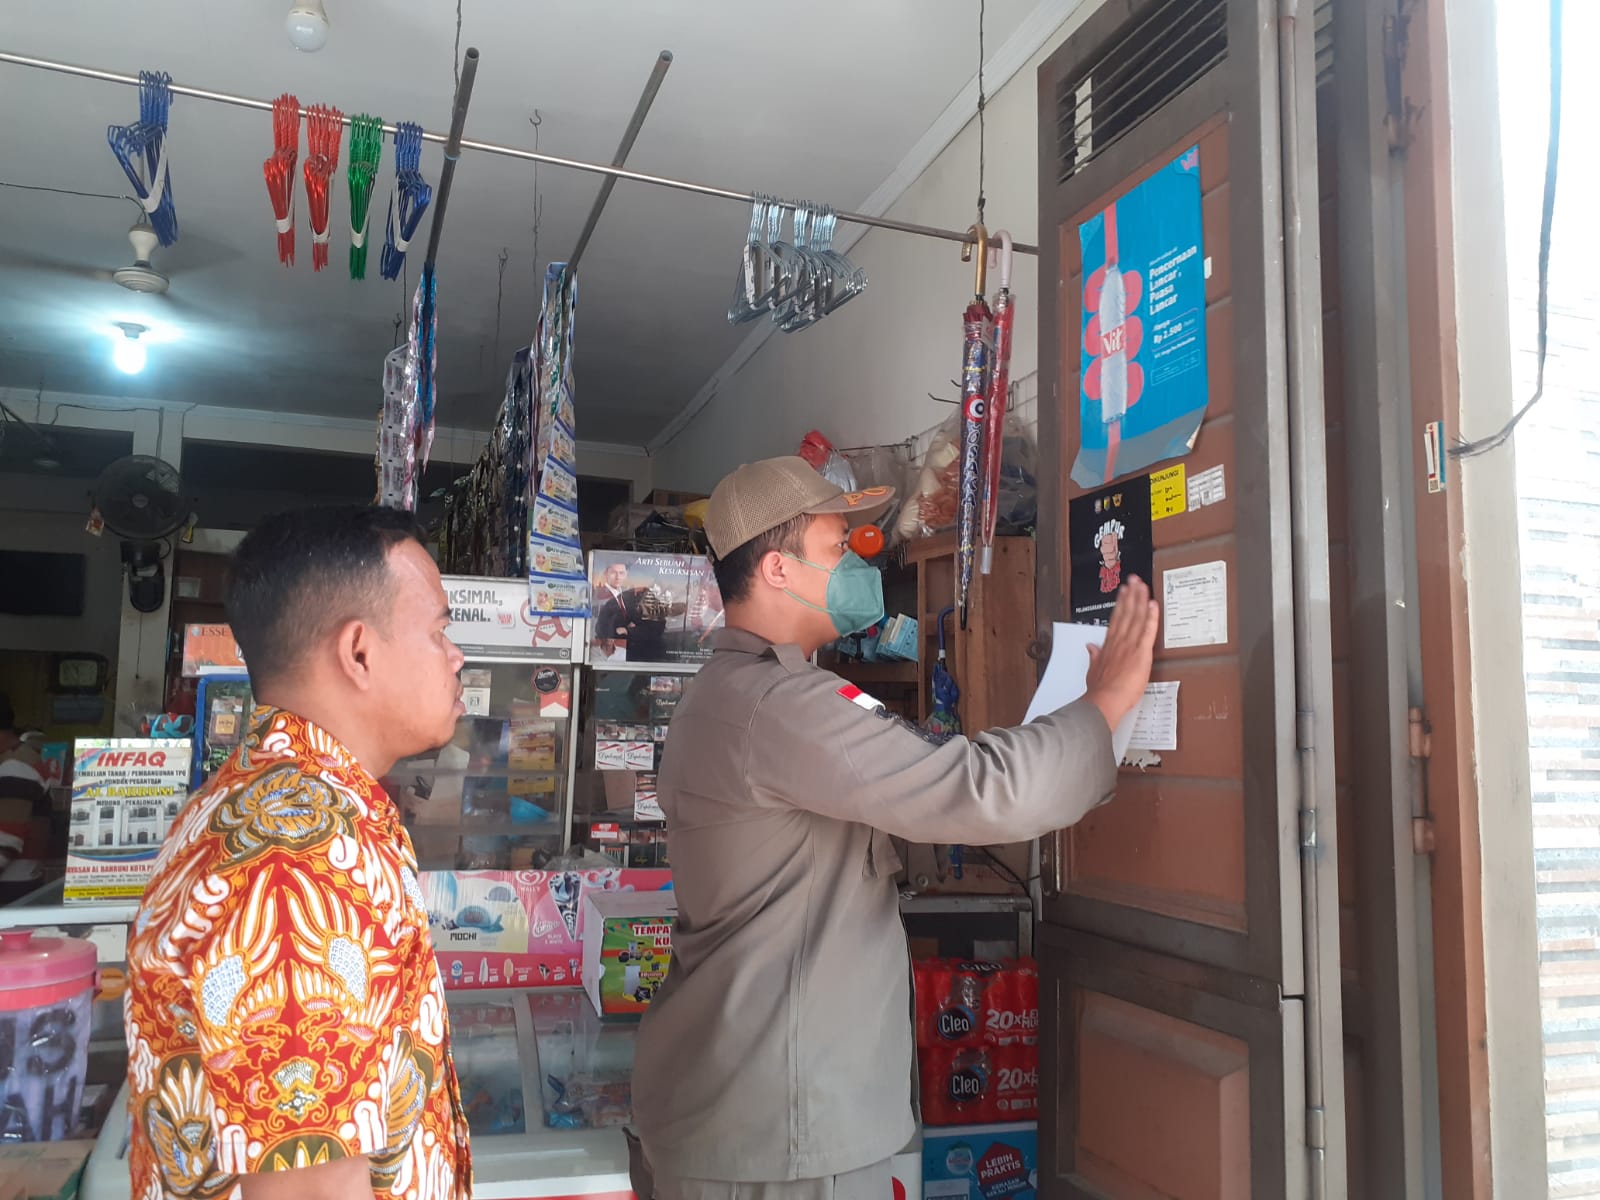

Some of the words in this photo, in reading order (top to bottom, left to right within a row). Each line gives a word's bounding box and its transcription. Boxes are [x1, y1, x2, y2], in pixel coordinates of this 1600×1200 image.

[1149, 245, 1197, 280] Pencernaan
[1149, 293, 1178, 316] Lancar
[1103, 326, 1123, 354] Vit
[1094, 518, 1125, 549] GEMPUR
[635, 556, 653, 566] ARTI
[654, 558, 685, 568] SEBUAH
[446, 589, 503, 606] KSIMAL,
[97, 751, 167, 768] INFAQ
[450, 932, 477, 941] MOCHI
[941, 1014, 970, 1033] Cleo
[952, 1075, 979, 1095] Cleo
[980, 1160, 1021, 1179] PRAKTIS
[985, 1153, 1013, 1169] LEBIH
